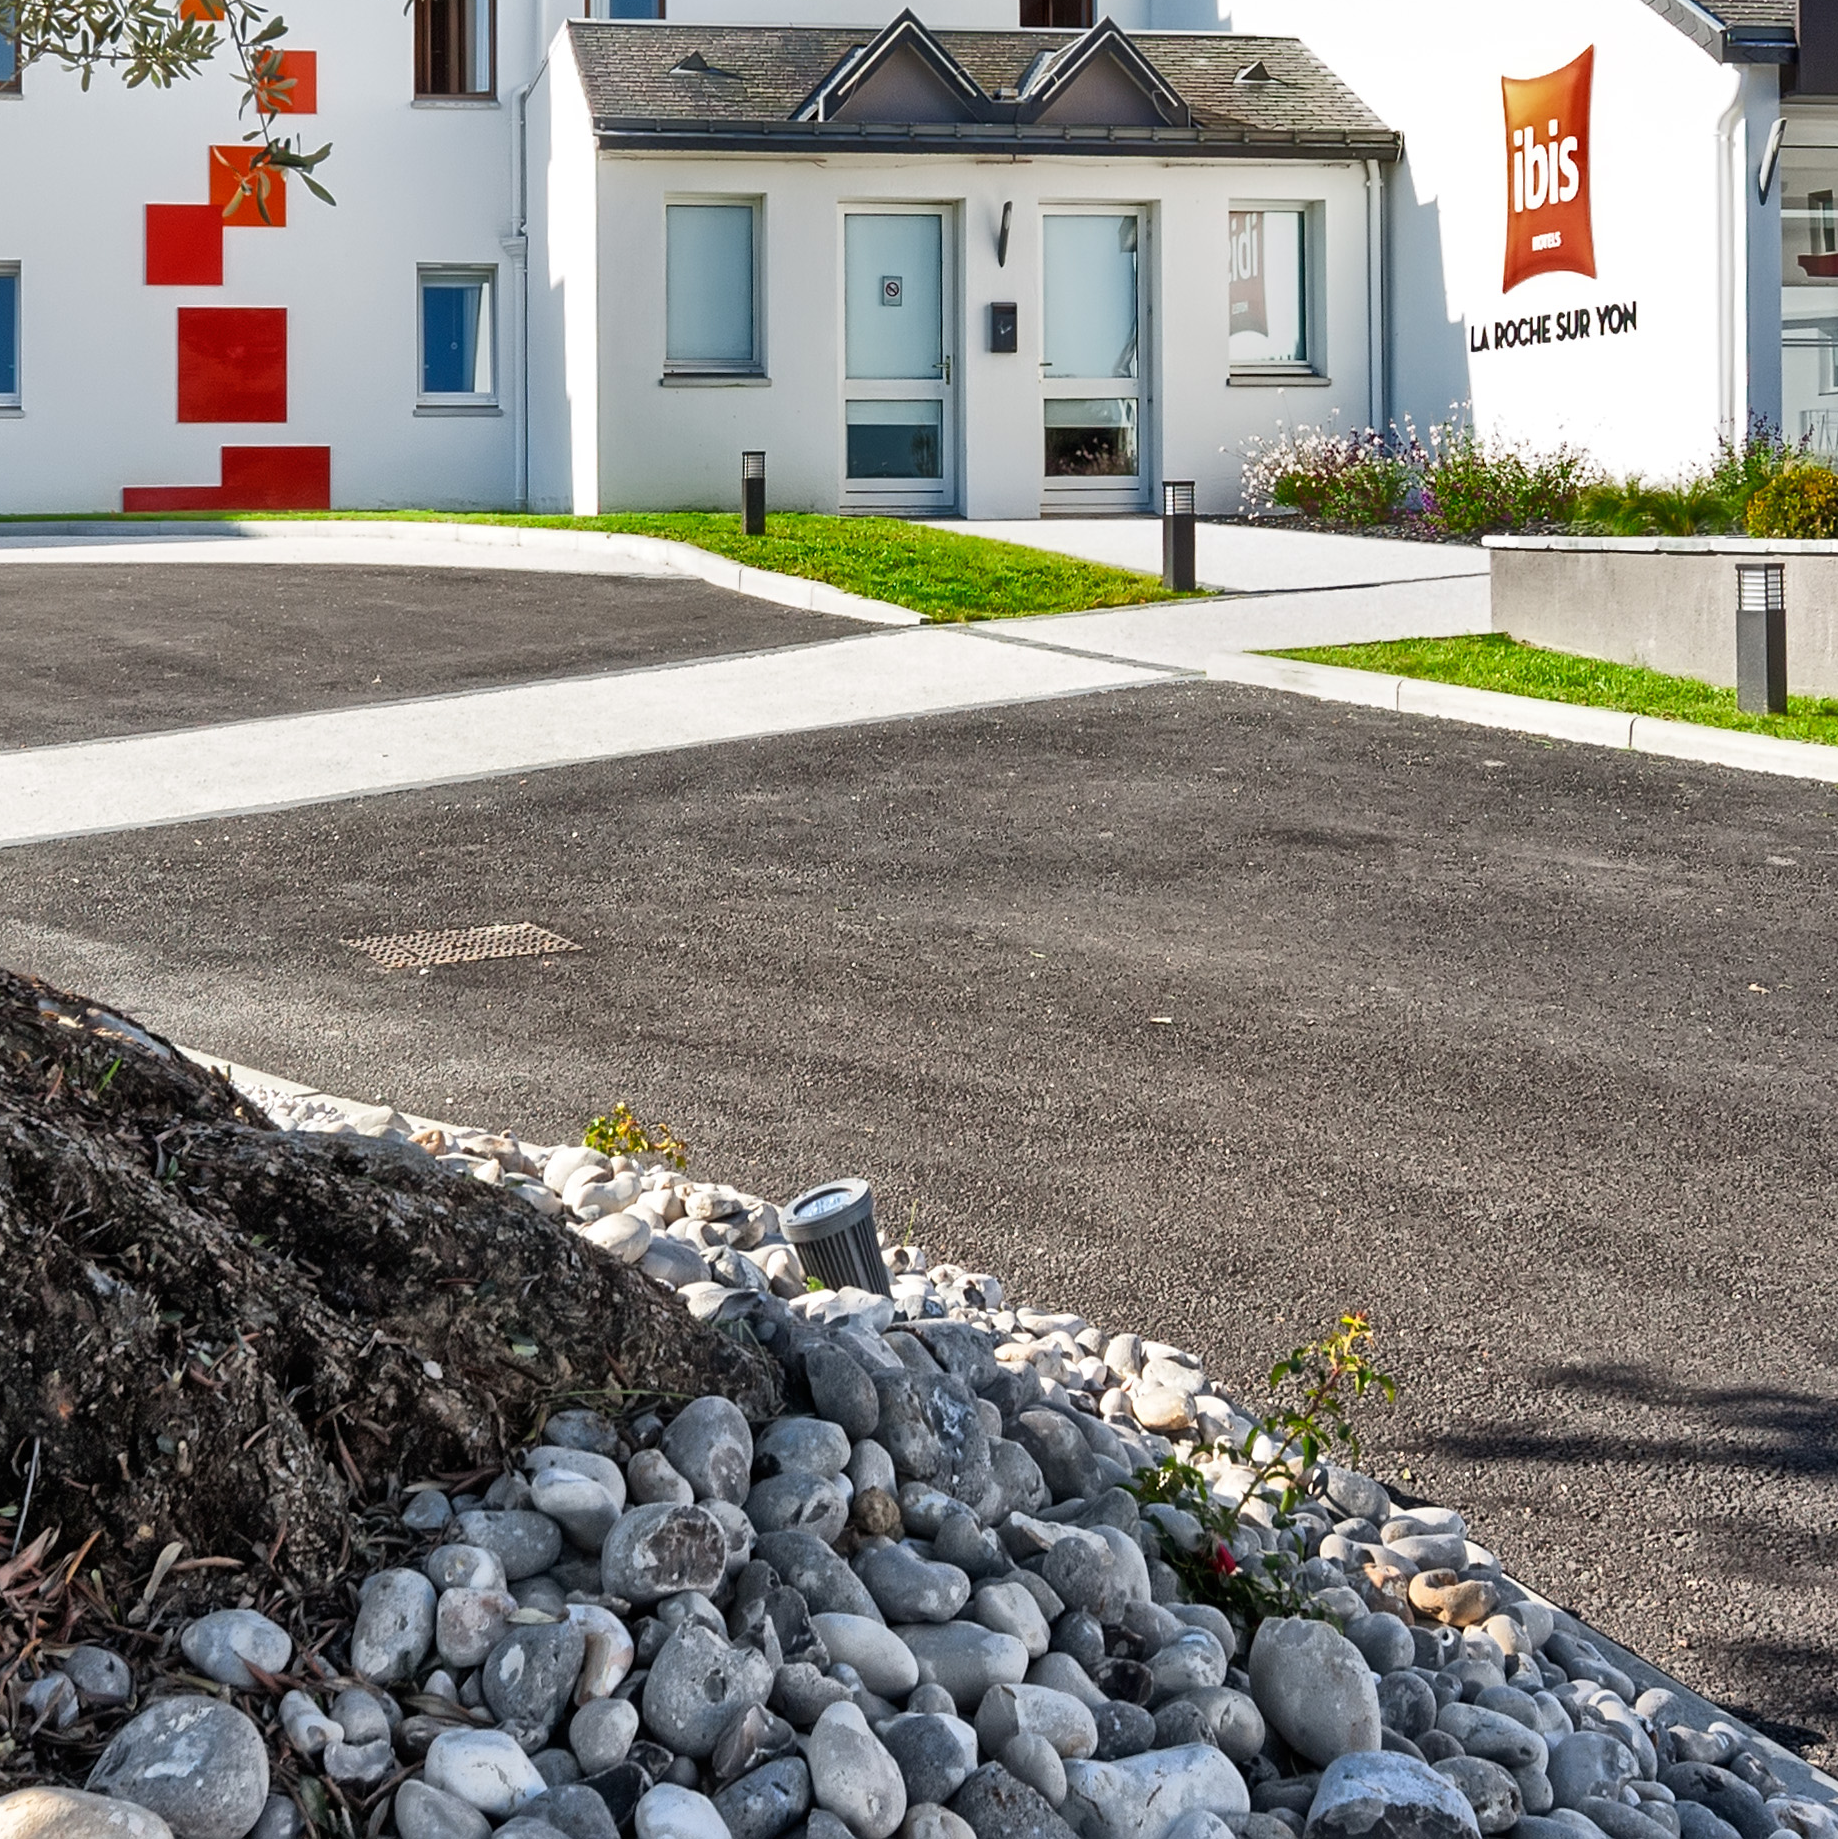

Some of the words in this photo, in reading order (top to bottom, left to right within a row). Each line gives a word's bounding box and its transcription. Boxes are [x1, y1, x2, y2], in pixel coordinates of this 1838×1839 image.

[1513, 118, 1579, 213] ibis
[1471, 323, 1490, 352] LA
[1495, 314, 1551, 349] ROCHE
[1556, 309, 1591, 340] SUR
[1595, 301, 1637, 335] YON
